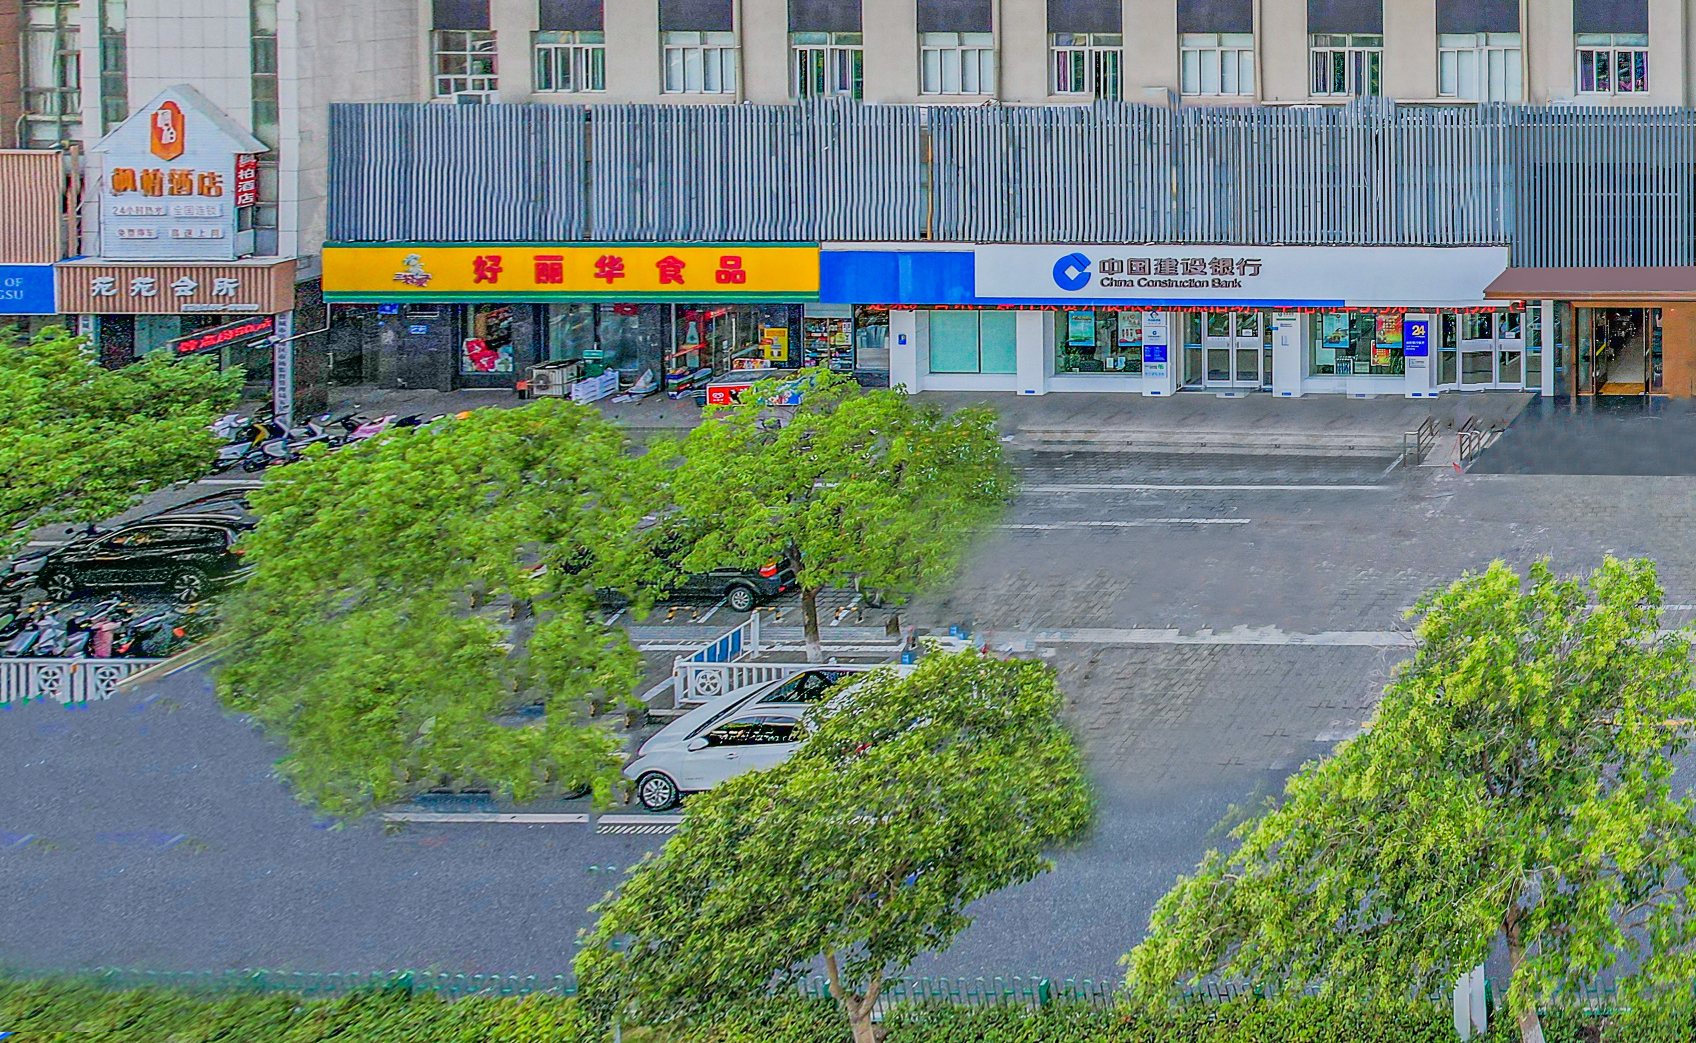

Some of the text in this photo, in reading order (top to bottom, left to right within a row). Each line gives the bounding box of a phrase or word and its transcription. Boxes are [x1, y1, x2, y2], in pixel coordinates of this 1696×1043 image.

[473, 254, 746, 285] 好丽华食品
[1098, 256, 1263, 277] 中国建设银行
[4, 277, 23, 287] OF
[1099, 277, 1242, 288] China Construction Bank
[1411, 324, 1426, 336] 24
